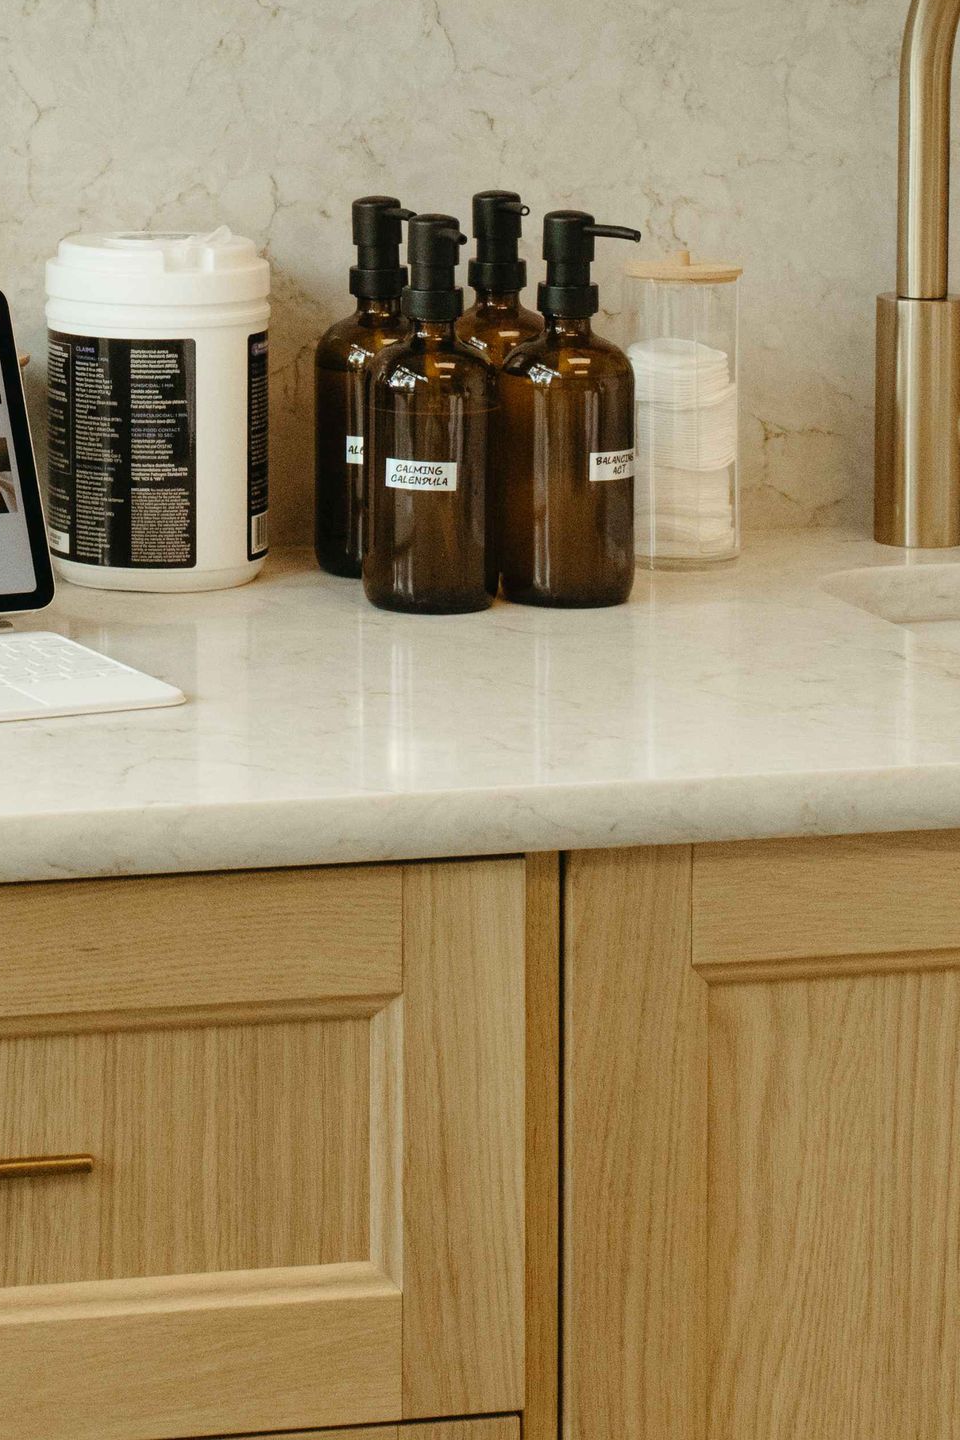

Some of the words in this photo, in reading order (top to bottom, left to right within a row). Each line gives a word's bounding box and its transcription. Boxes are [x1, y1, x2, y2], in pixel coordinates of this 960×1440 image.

[395, 464, 444, 476] CALMING
[612, 464, 627, 475] ACT
[390, 474, 448, 486] CALENDULA
